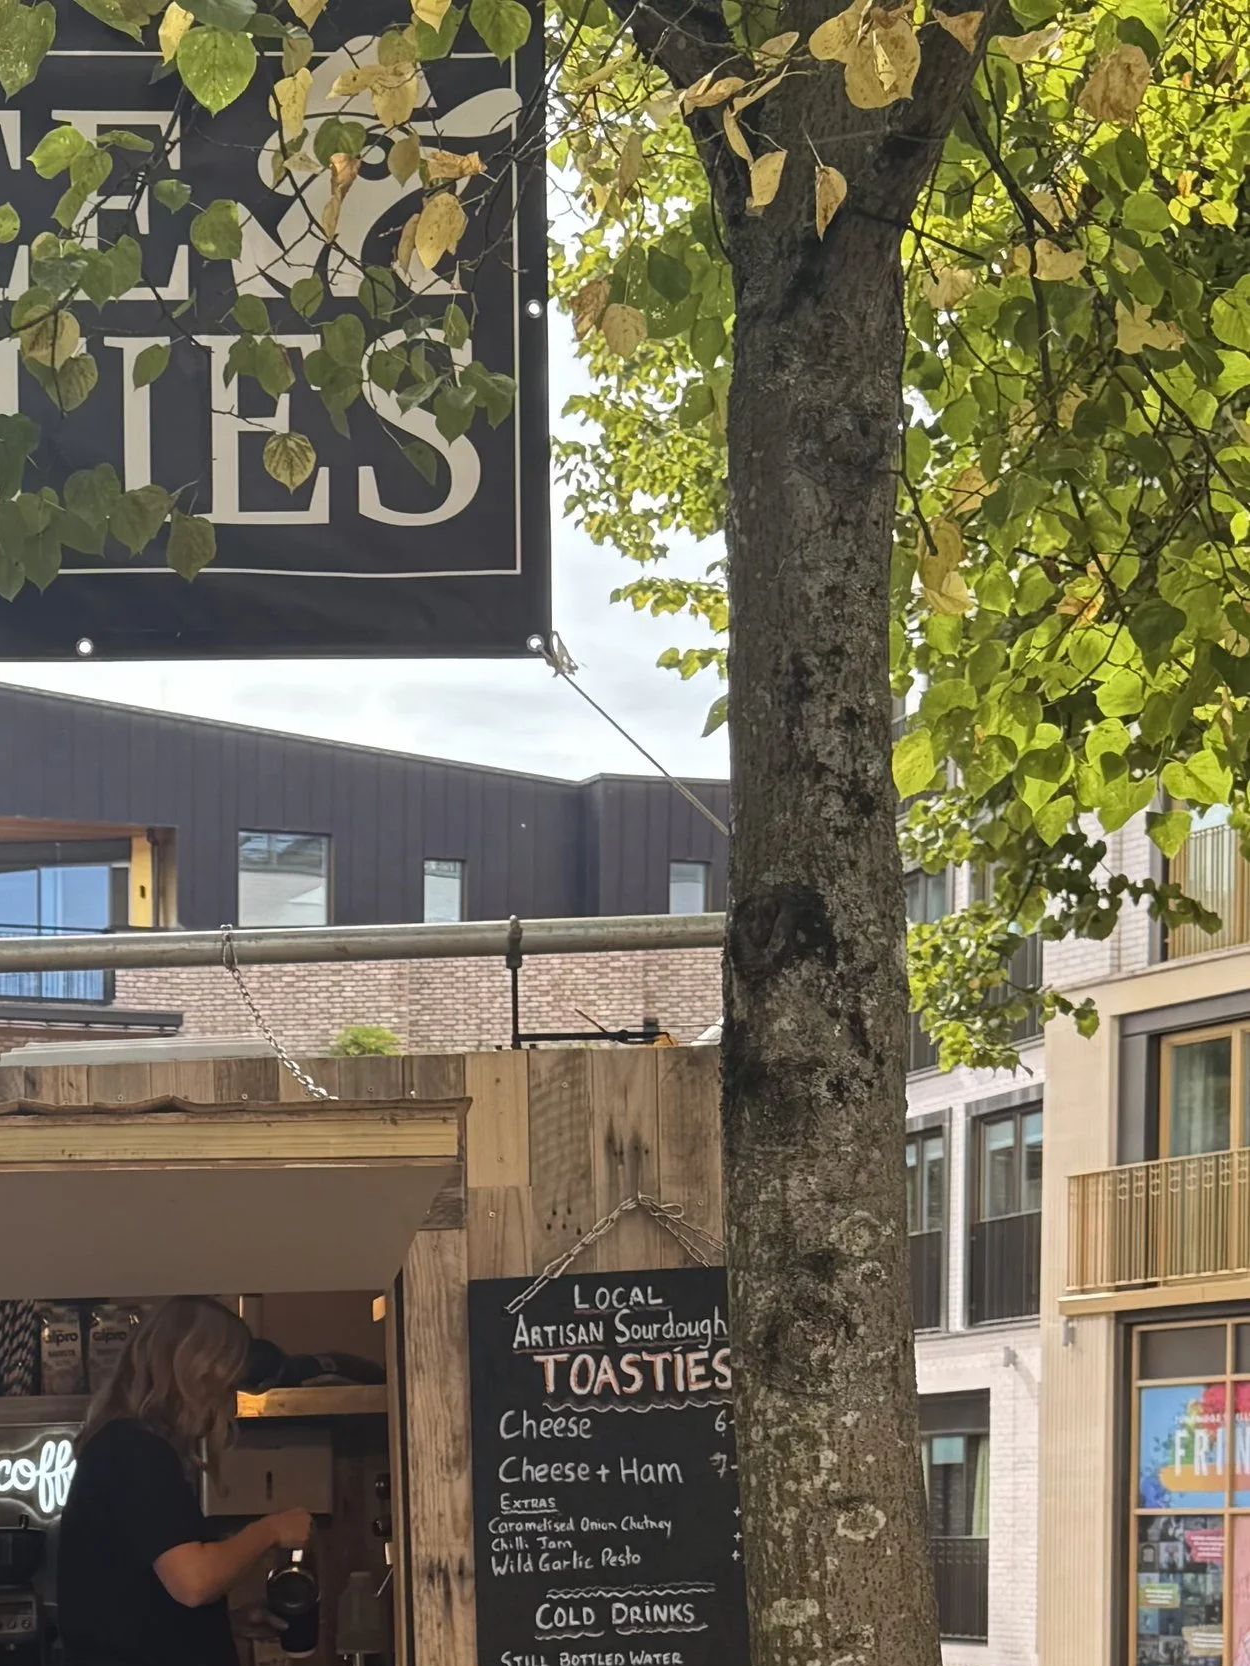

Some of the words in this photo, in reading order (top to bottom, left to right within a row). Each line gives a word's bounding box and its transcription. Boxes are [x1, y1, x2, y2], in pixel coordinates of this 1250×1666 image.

[574, 1284, 662, 1309] LOCAL
[513, 1314, 603, 1348] ARTISAN
[615, 1306, 728, 1349] Sourdough
[533, 1347, 732, 1395] TOASTIES
[500, 1410, 593, 1439] Cheese
[498, 1456, 590, 1483] Cheese
[620, 1456, 684, 1485] Ham
[500, 1493, 556, 1510] EXTRAS
[580, 1518, 617, 1532] Onion
[620, 1514, 672, 1539] Chutney
[491, 1536, 529, 1551] Chilli
[536, 1536, 572, 1550] Jam
[491, 1553, 534, 1576] Wild
[539, 1549, 594, 1572] Garlic
[601, 1545, 641, 1567] Pesto
[535, 1603, 596, 1629] COLD
[629, 1650, 683, 1666] WATER
